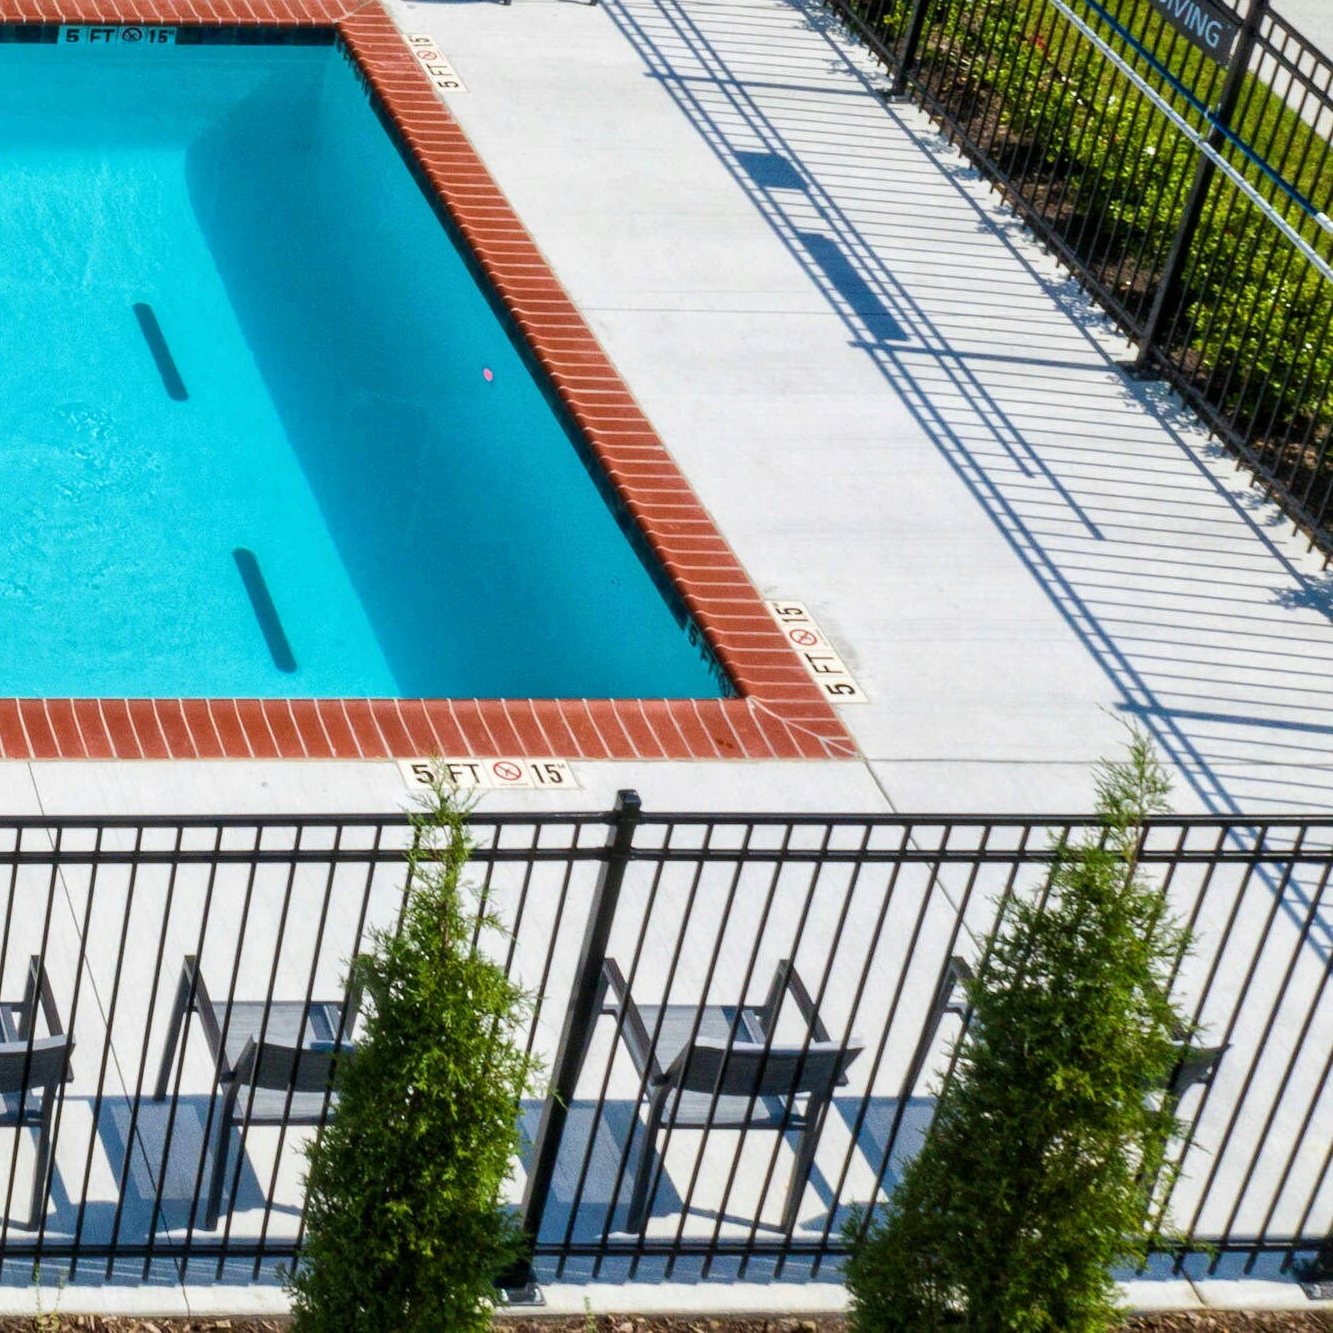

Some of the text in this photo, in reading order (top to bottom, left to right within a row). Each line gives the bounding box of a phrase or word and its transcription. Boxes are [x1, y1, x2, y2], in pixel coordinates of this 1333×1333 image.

[65, 28, 80, 43] 5
[89, 28, 115, 43] FT
[804, 652, 844, 674] FT
[824, 683, 856, 696] 5
[410, 763, 436, 784] 5
[445, 763, 481, 784] FT
